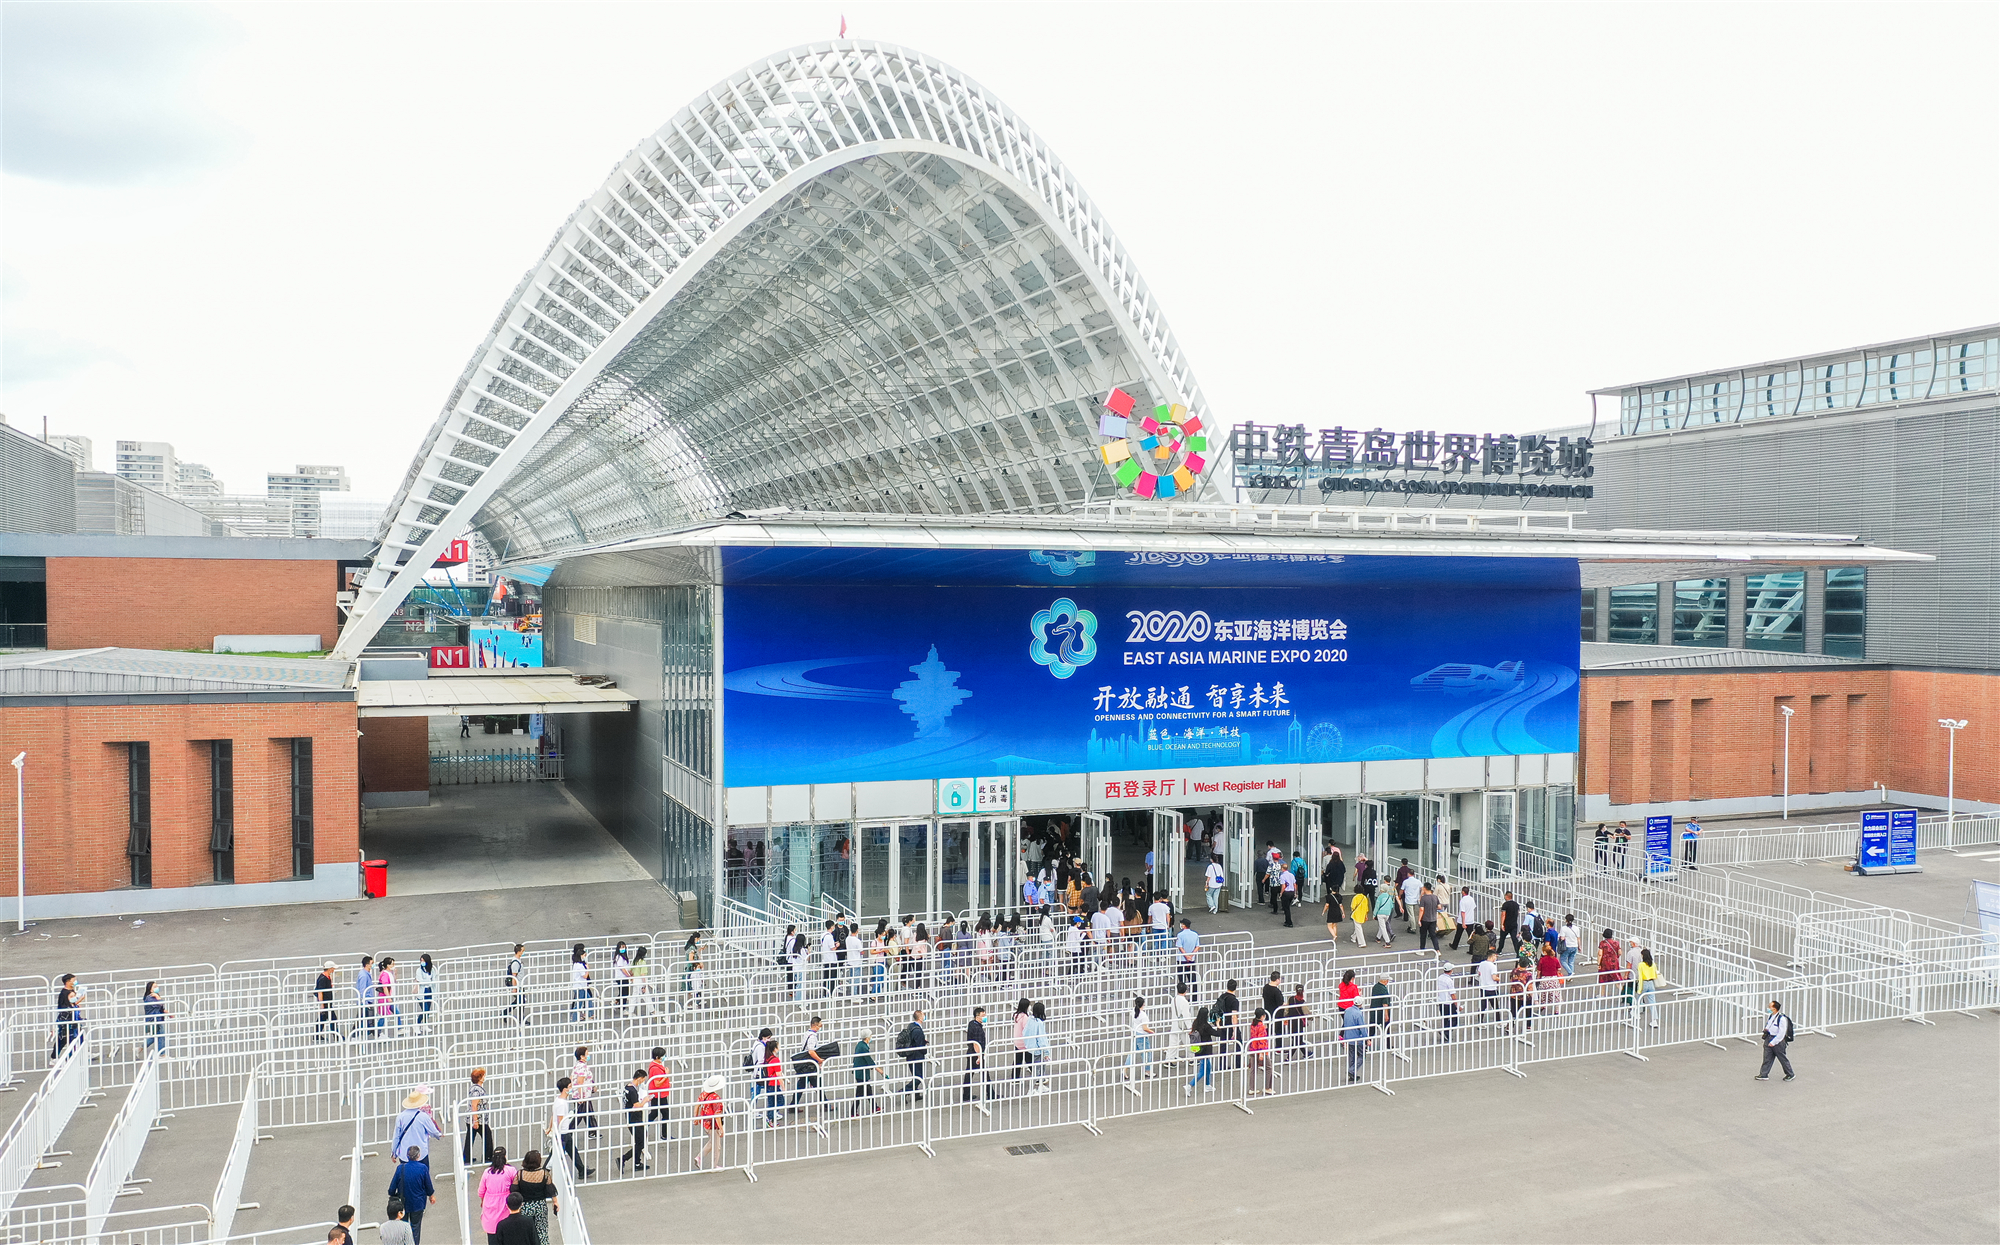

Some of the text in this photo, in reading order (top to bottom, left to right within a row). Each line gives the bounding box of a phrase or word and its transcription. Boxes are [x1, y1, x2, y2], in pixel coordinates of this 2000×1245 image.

[1230, 421, 1594, 478] 中铁青岛世界博览城
[1318, 477, 1392, 494] QINGDAO
[1509, 483, 1593, 498] EXPOSITION
[1125, 610, 1347, 642] 2020 东亚海洋博览会
[436, 648, 464, 666] N1
[1123, 649, 1348, 665] EAST ASIA MARINE EXPO 2020
[1093, 681, 1290, 712] 开放融通 智享未来
[1094, 713, 1136, 721] OPENNESS
[1156, 712, 1210, 720] CONNECTIVITY
[1212, 711, 1227, 719] FOR
[1235, 710, 1261, 718] SMART
[1187, 742, 1200, 750] AND
[1201, 741, 1241, 749] TECHNOLOGY
[978, 785, 1008, 794] 此区域
[1105, 779, 1176, 799] 西登录厅
[1193, 778, 1286, 793] West Register Hall
[979, 794, 1008, 804] 已消毒
